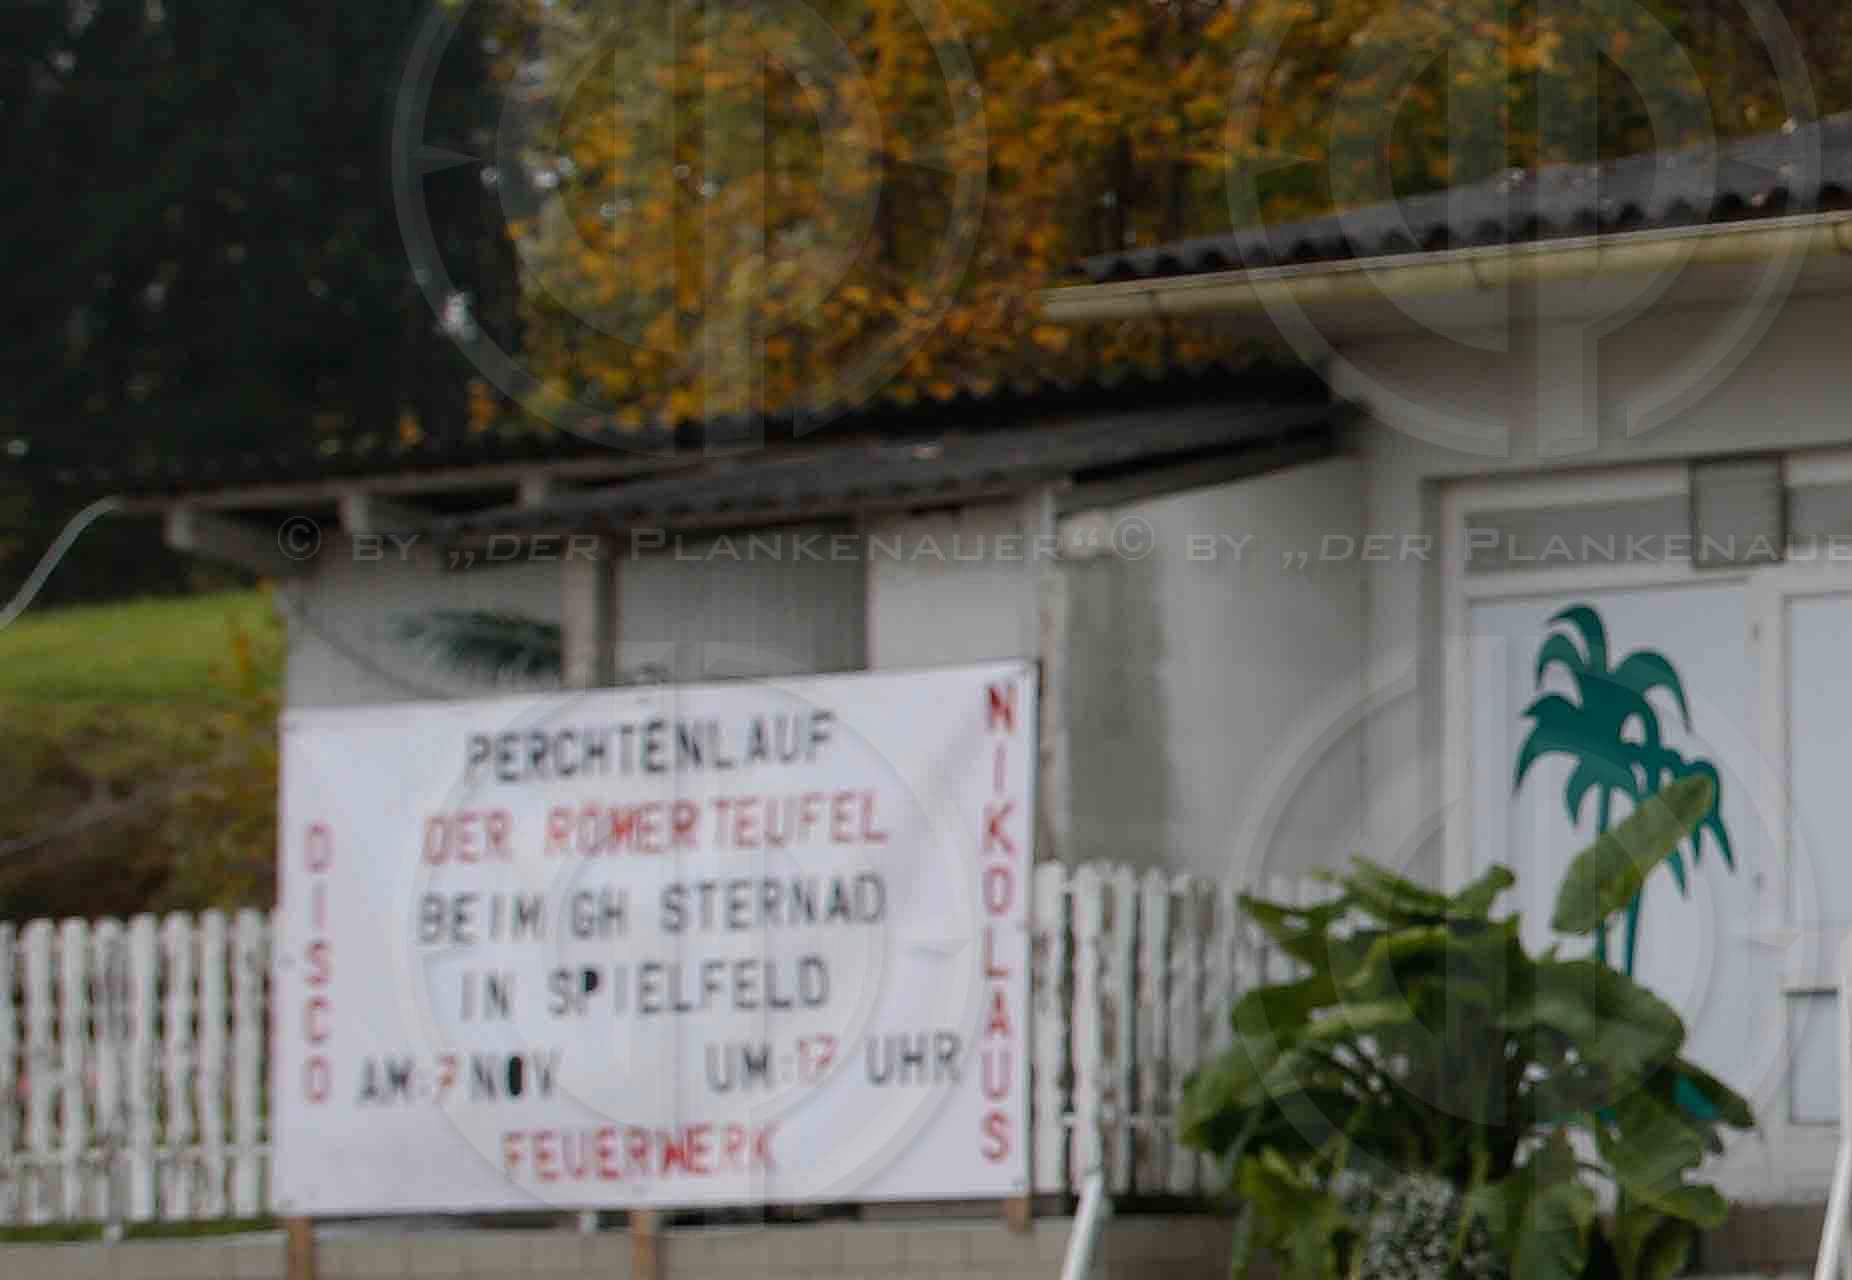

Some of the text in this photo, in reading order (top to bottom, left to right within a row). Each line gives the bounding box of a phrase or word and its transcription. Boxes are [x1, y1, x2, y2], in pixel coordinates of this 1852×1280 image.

[465, 711, 836, 785] PERCHTENLAUF
[423, 809, 513, 865] DER
[415, 871, 887, 945] BEIM GH STERNAD
[980, 682, 1018, 1165] NIKOLAUS
[302, 822, 335, 1105] DISCO
[460, 956, 831, 1021] IN SPIELFELD
[864, 1030, 963, 1088] UHR
[502, 1120, 783, 1183] FEUERWERK
